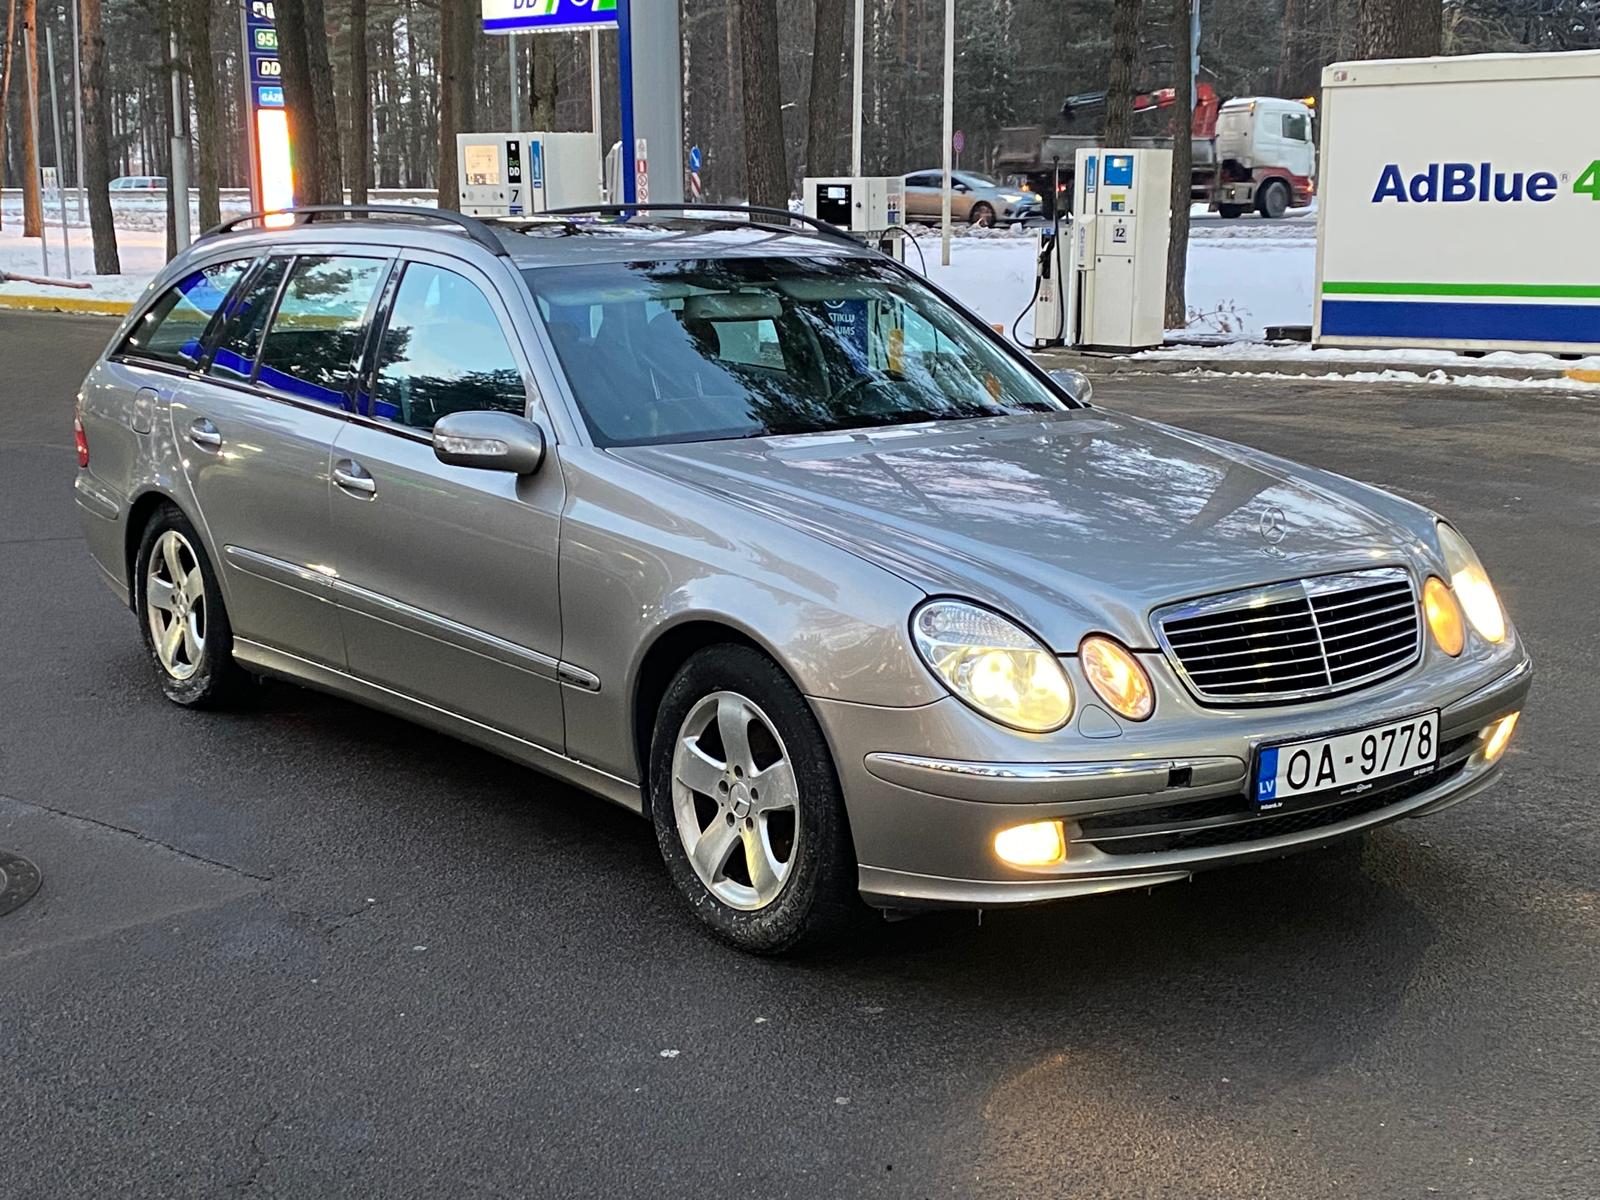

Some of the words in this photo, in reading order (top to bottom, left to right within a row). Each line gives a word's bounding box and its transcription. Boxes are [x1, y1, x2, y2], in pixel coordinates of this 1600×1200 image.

[260, 61, 281, 76] DD
[1572, 159, 1600, 201] 4
[511, 189, 519, 203] 7
[1115, 227, 1126, 238] 12
[1259, 779, 1274, 795] LV
[1287, 720, 1432, 789] OA-9778
